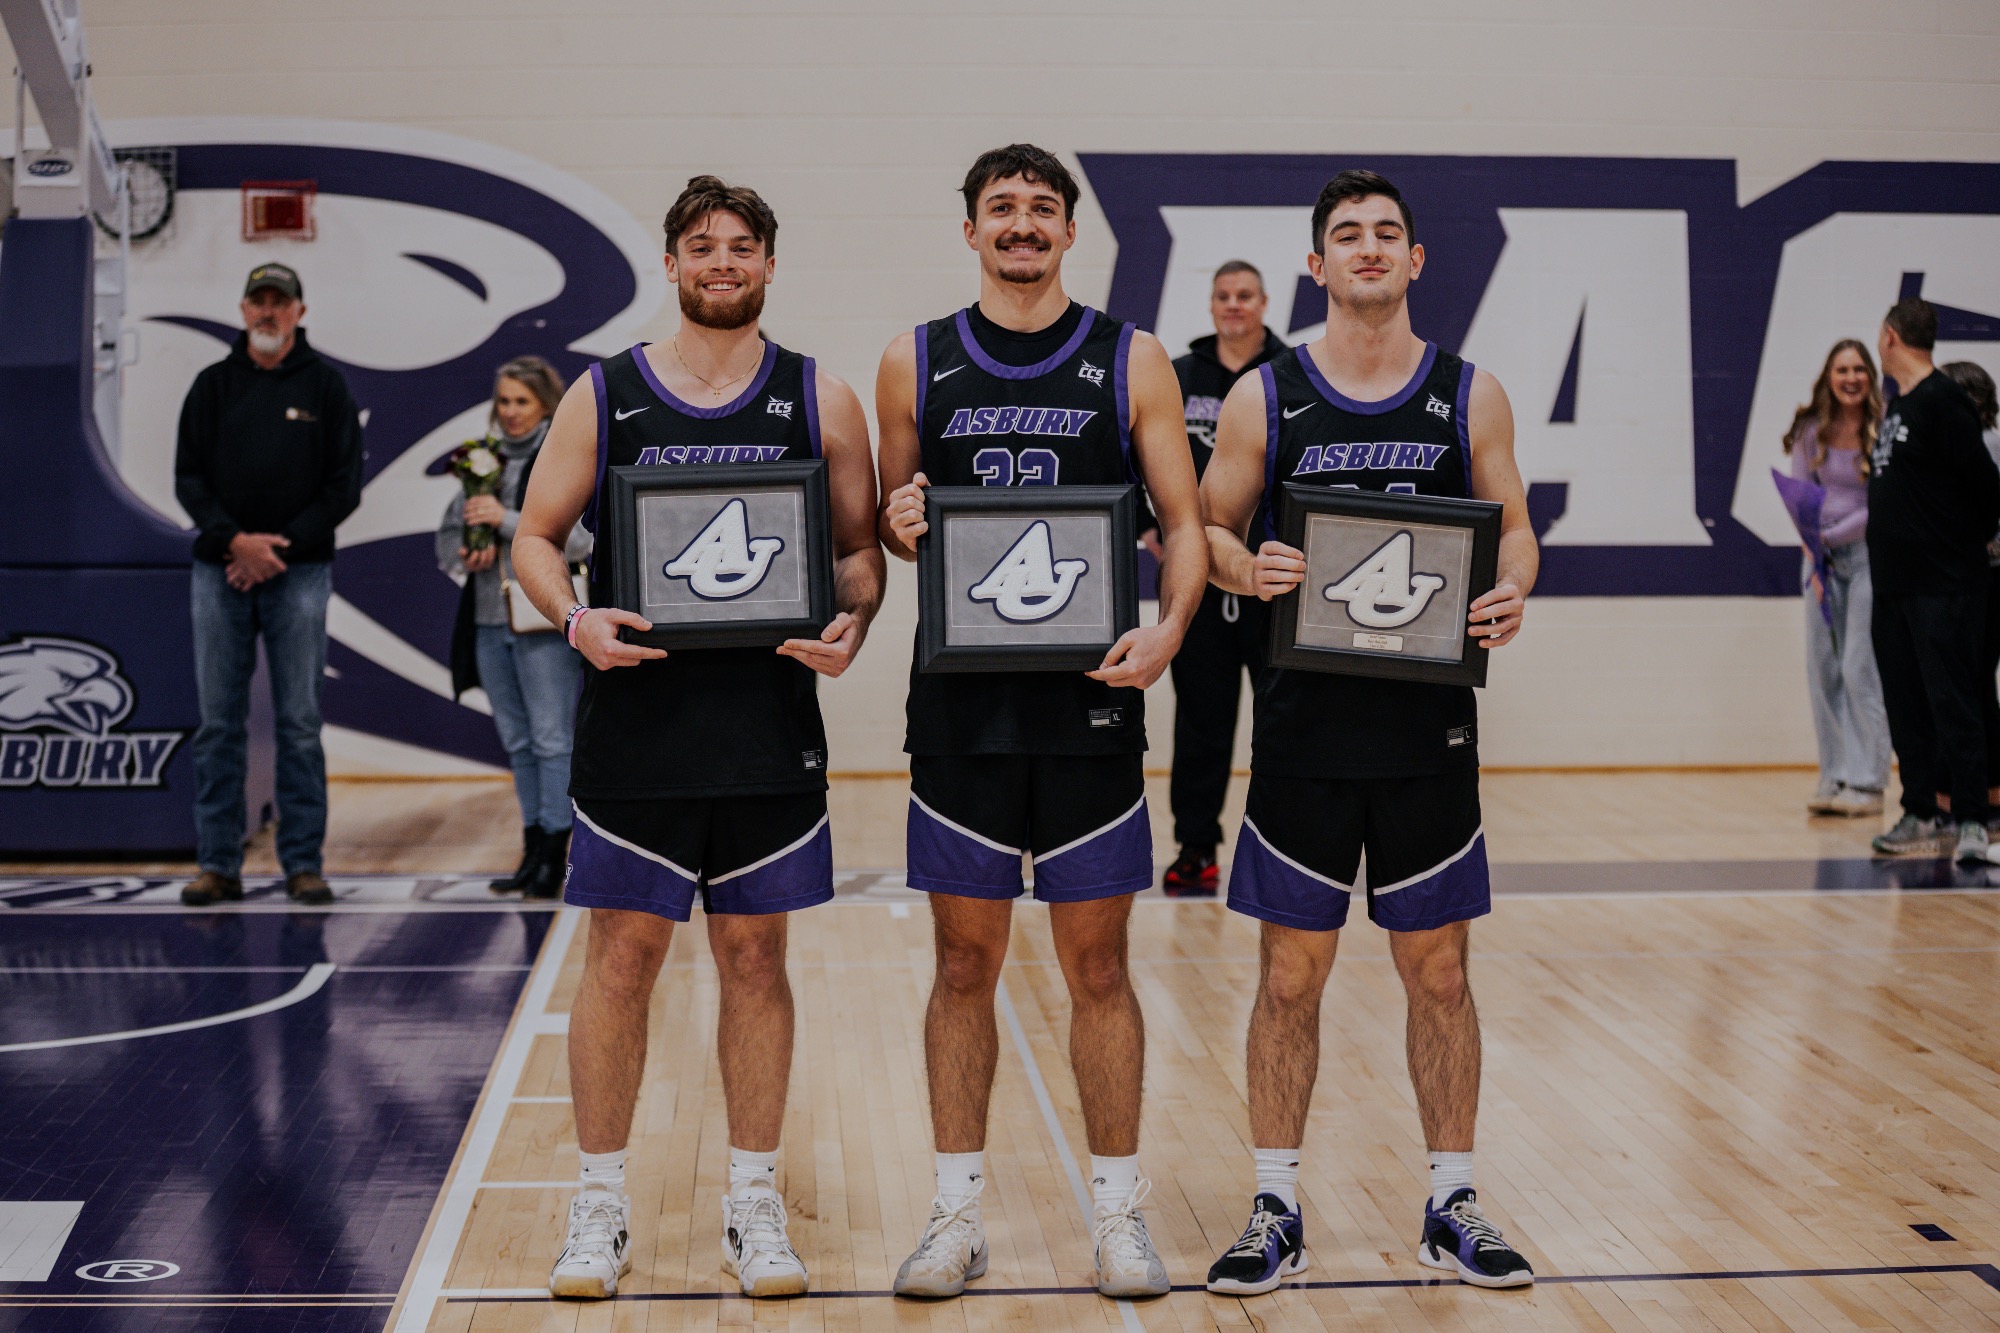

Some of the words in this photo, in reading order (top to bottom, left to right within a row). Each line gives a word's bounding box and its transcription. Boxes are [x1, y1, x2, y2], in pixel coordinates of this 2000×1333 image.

[1078, 364, 1105, 382] CCS
[766, 399, 794, 416] CCS
[1425, 399, 1451, 416] CCS
[940, 406, 1099, 438] ASBURY
[1290, 442, 1451, 476] ASBURY
[0, 732, 184, 787] BURY
